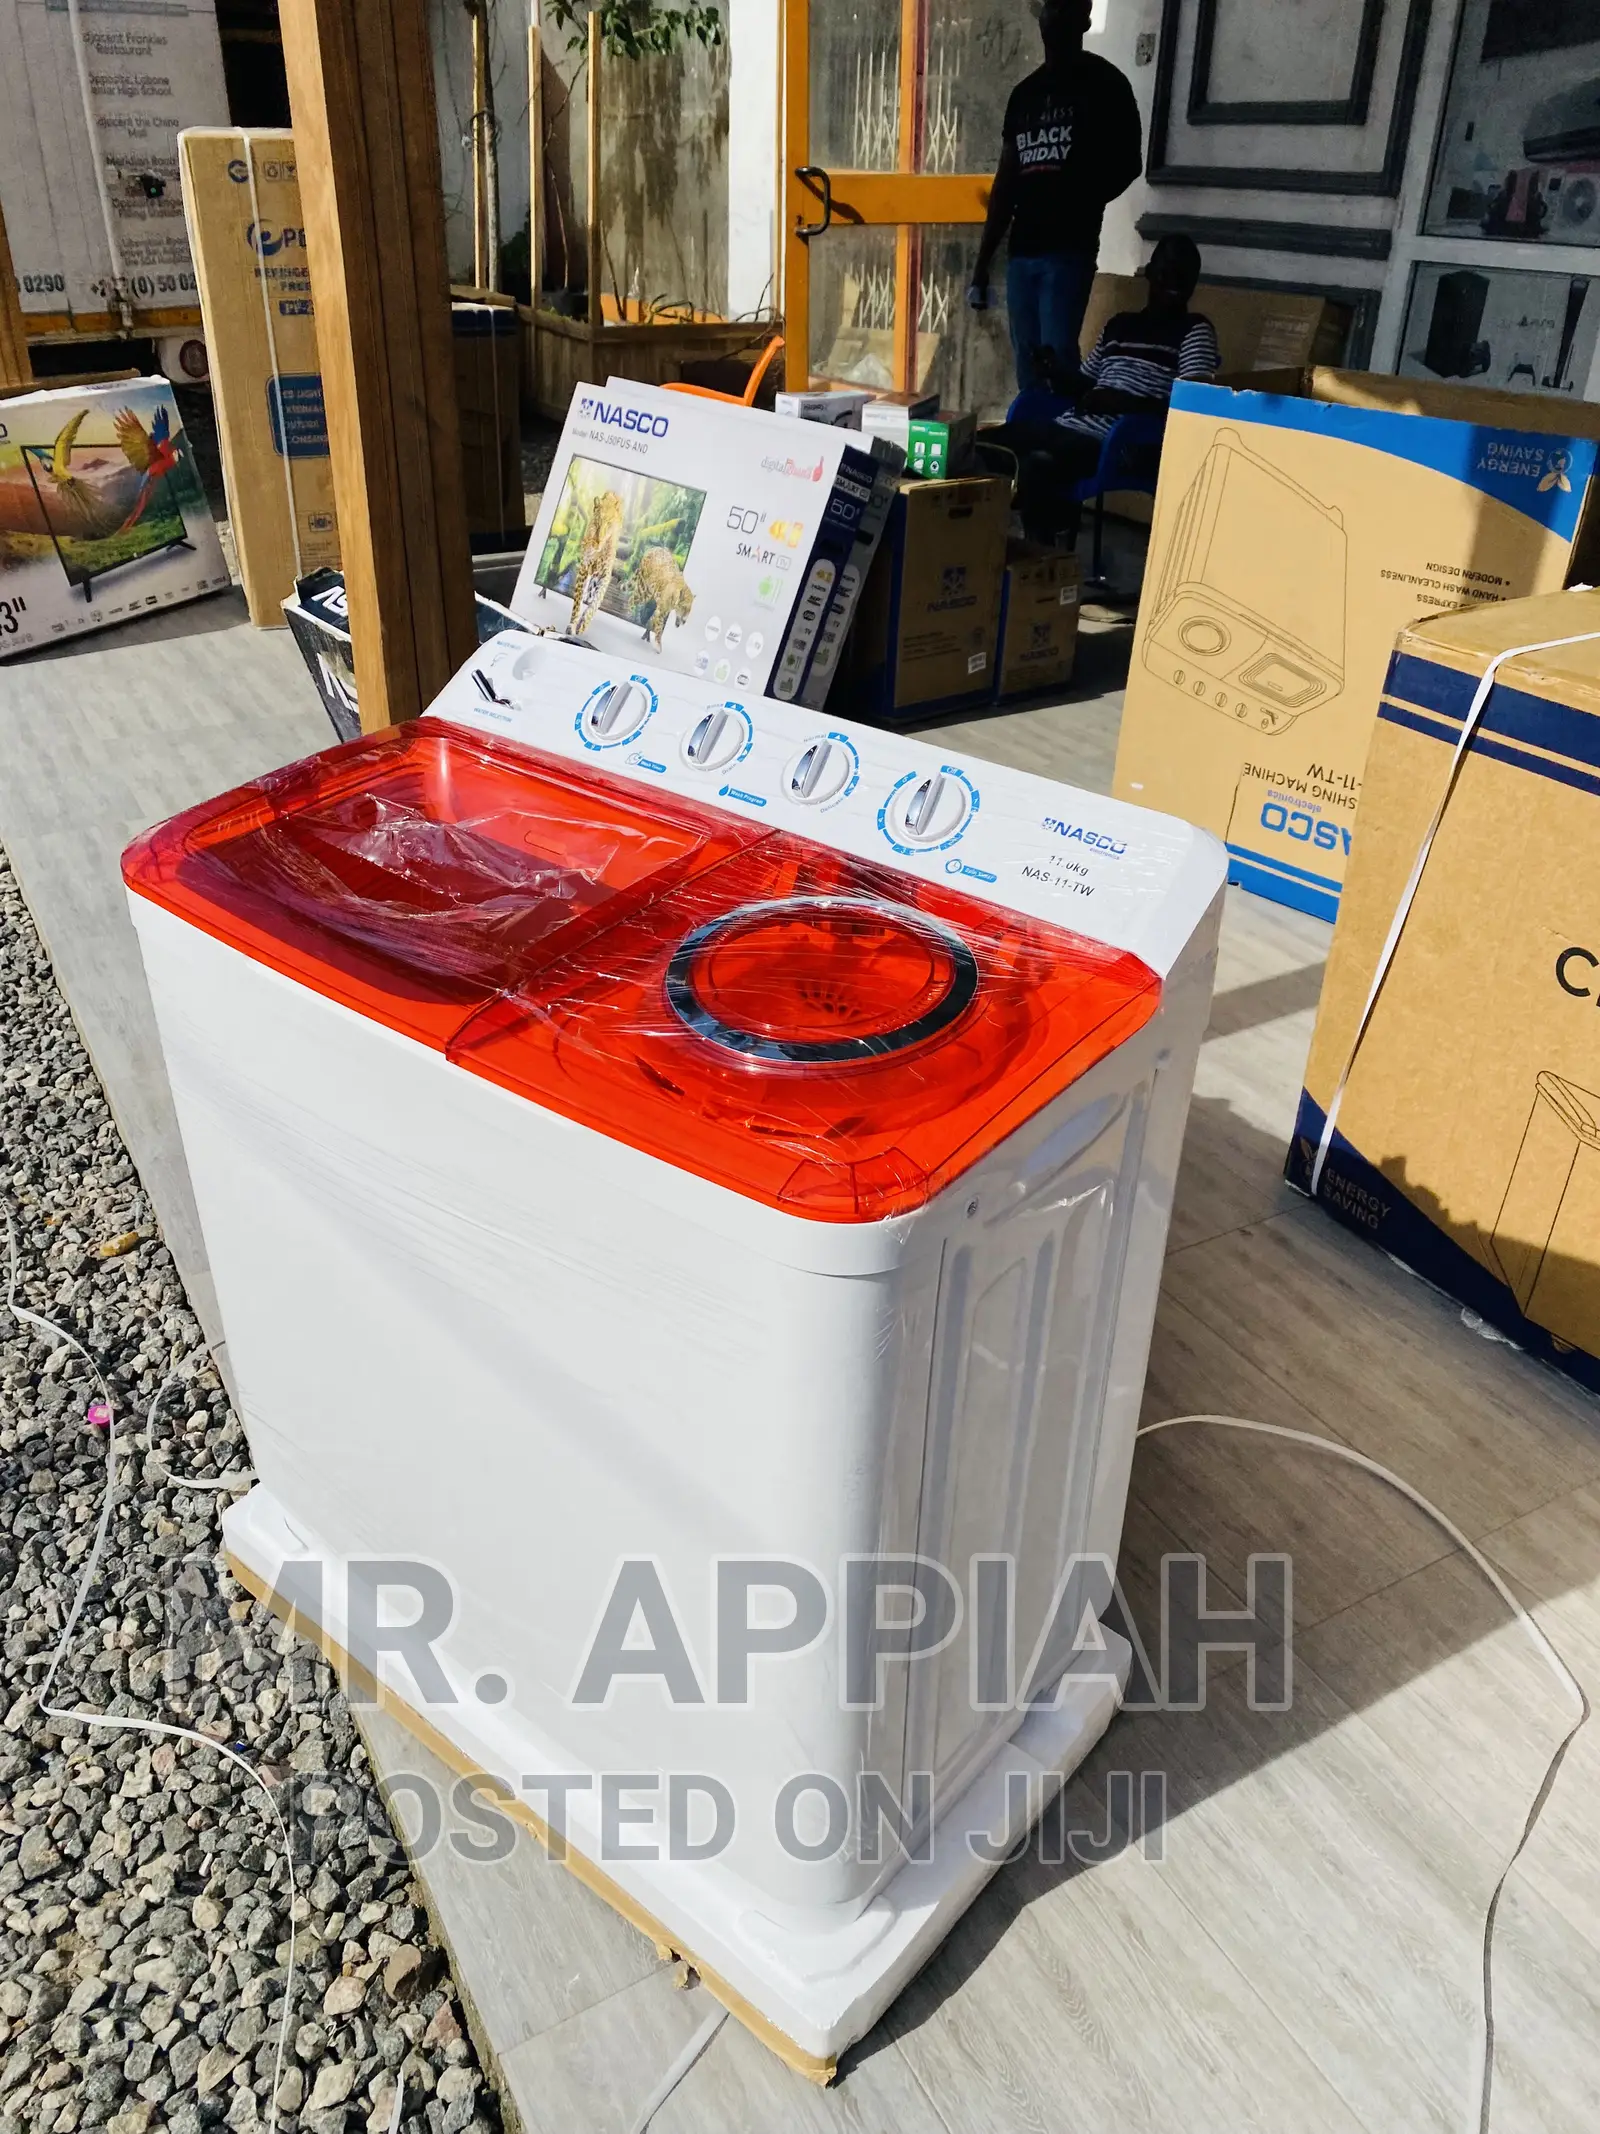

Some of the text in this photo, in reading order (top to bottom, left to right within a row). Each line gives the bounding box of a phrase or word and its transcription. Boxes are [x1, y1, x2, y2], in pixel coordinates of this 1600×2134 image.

[1016, 125, 1073, 151] BLACK
[24, 274, 65, 293] 0290
[593, 401, 670, 438] NASCO
[1487, 442, 1544, 461] SAVING
[1477, 457, 1541, 477] ENERGY
[736, 542, 776, 566] SMART
[1380, 569, 1499, 602] HAND WASH CLEANLINESS
[1426, 562, 1503, 585] MODERN DESIGN
[1416, 593, 1458, 609] EXPRESS
[1244, 762, 1308, 794] MACHINE
[1267, 789, 1322, 813] electronics
[1053, 821, 1128, 855] NASCO
[1021, 866, 1096, 897] NAS-11-TW
[1555, 947, 1600, 1008] C
[1325, 1167, 1392, 1217] ENERGY
[1323, 1183, 1380, 1230] SAVING
